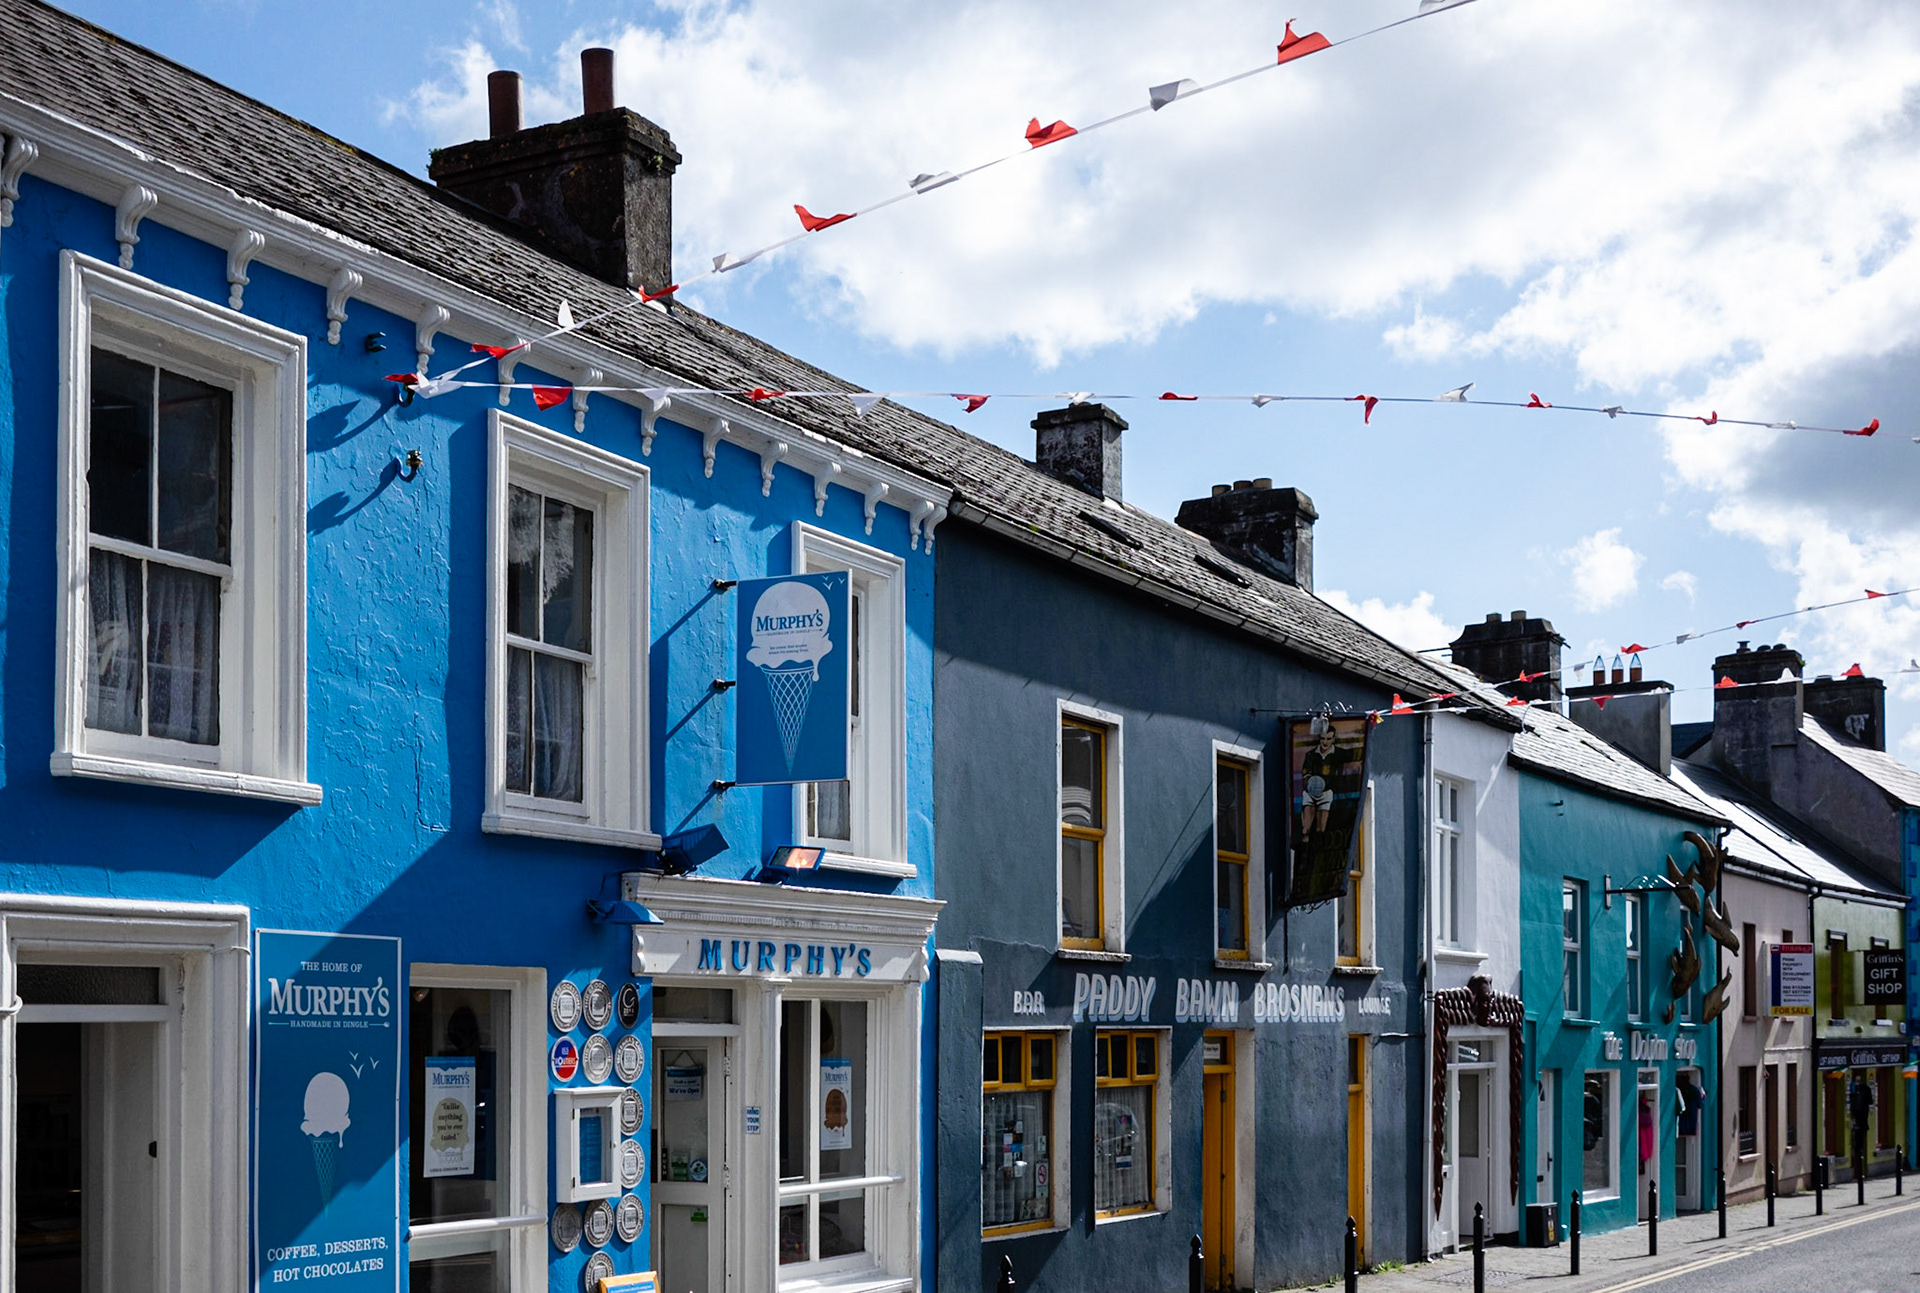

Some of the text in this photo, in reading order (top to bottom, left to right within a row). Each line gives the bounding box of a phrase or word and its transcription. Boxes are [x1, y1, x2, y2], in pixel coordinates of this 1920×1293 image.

[756, 608, 824, 632] MURPHY'S
[301, 961, 362, 973] THE HOME OF
[698, 938, 872, 976] MURPHY'S
[1870, 968, 1898, 979] GIFT
[268, 976, 390, 1017] MURPHY'S
[1013, 973, 1391, 1023] BAR PADDY BAWN BROSNANS LOUNGE
[1868, 983, 1902, 994] SHOP
[1851, 1050, 1877, 1064] Griffin's
[432, 1071, 470, 1085] MURPHY'S
[267, 1236, 388, 1262] COFFEE, DESSERTS,
[273, 1258, 384, 1282] HOT CHOCOLATES
